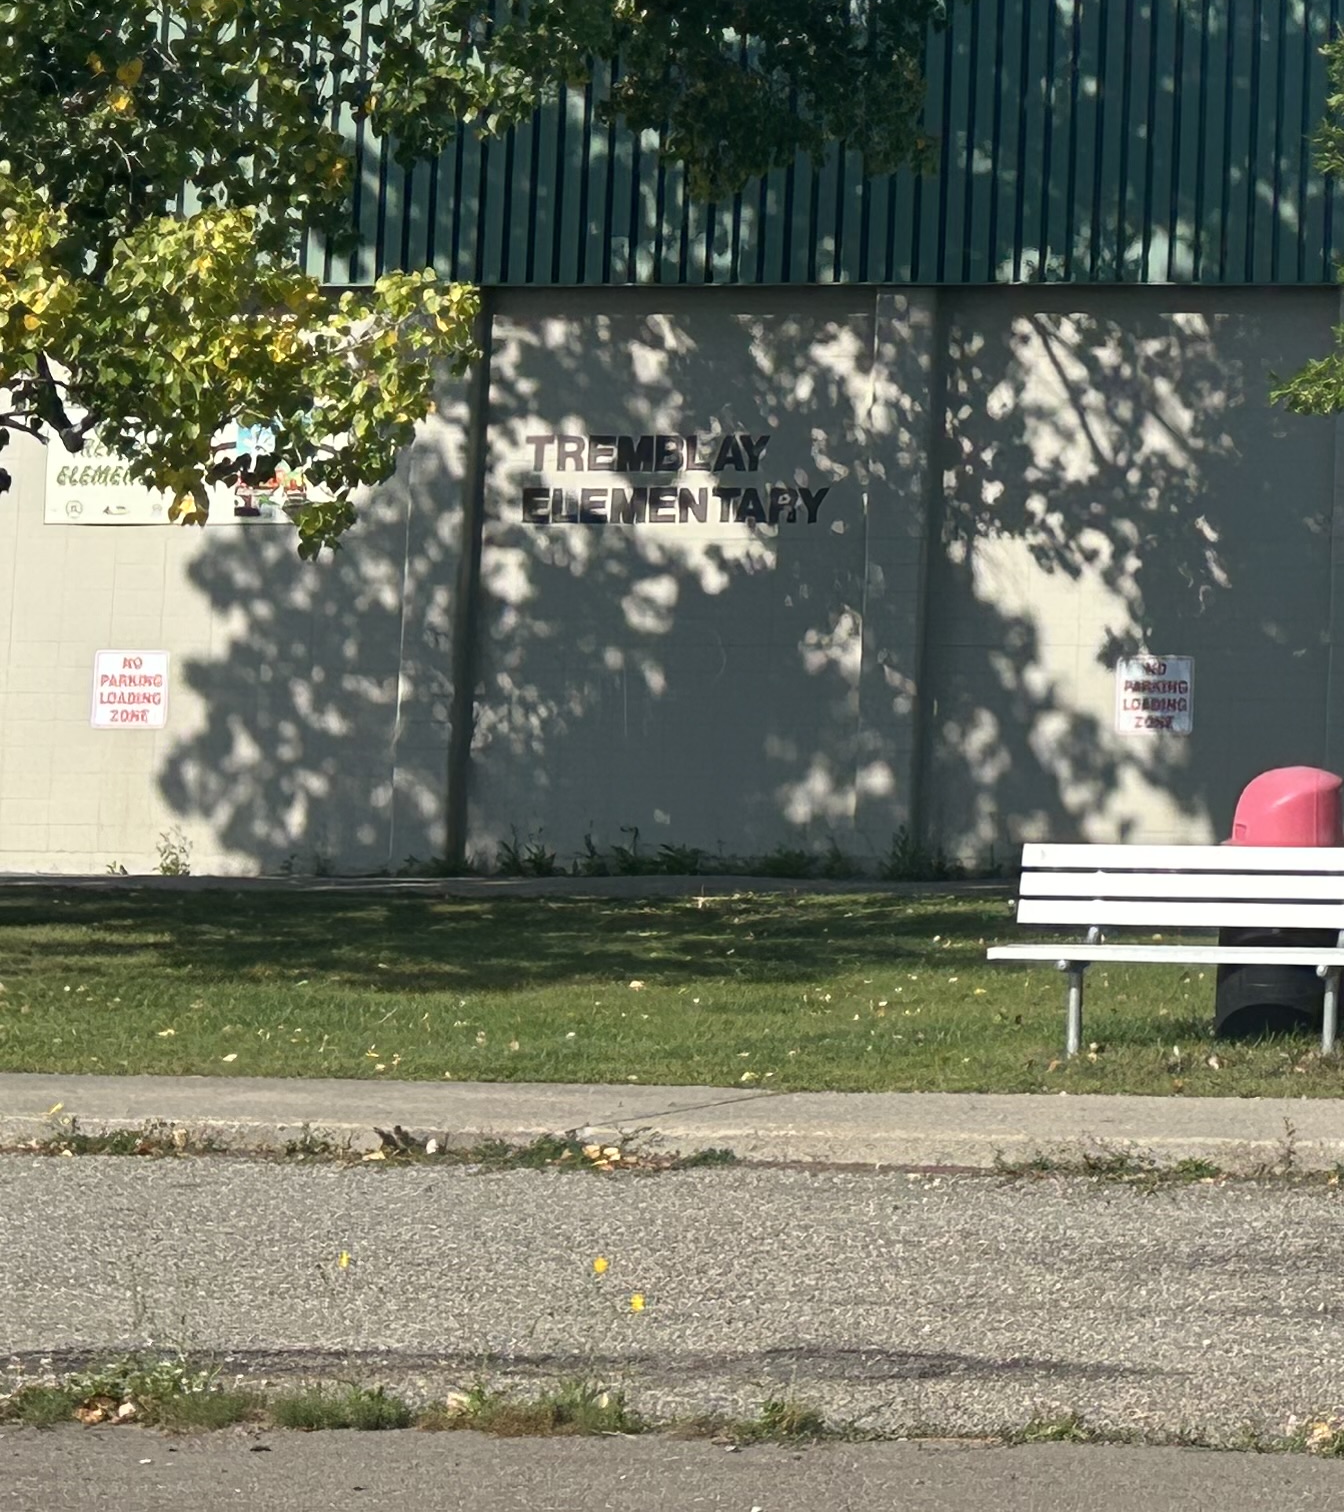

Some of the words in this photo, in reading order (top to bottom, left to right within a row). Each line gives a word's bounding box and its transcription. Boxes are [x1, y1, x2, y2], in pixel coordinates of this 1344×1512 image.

[526, 434, 770, 471] TREMBLAY
[521, 487, 830, 523] ELEMENTARY
[123, 657, 143, 669] NO
[1144, 662, 1167, 676] NO
[101, 674, 162, 687] PARKING
[1124, 680, 1188, 694] PARKING
[100, 691, 161, 705] LOADING
[1123, 698, 1188, 712] LOADING
[110, 709, 149, 722] ZONE
[1135, 715, 1174, 729] ZONE
